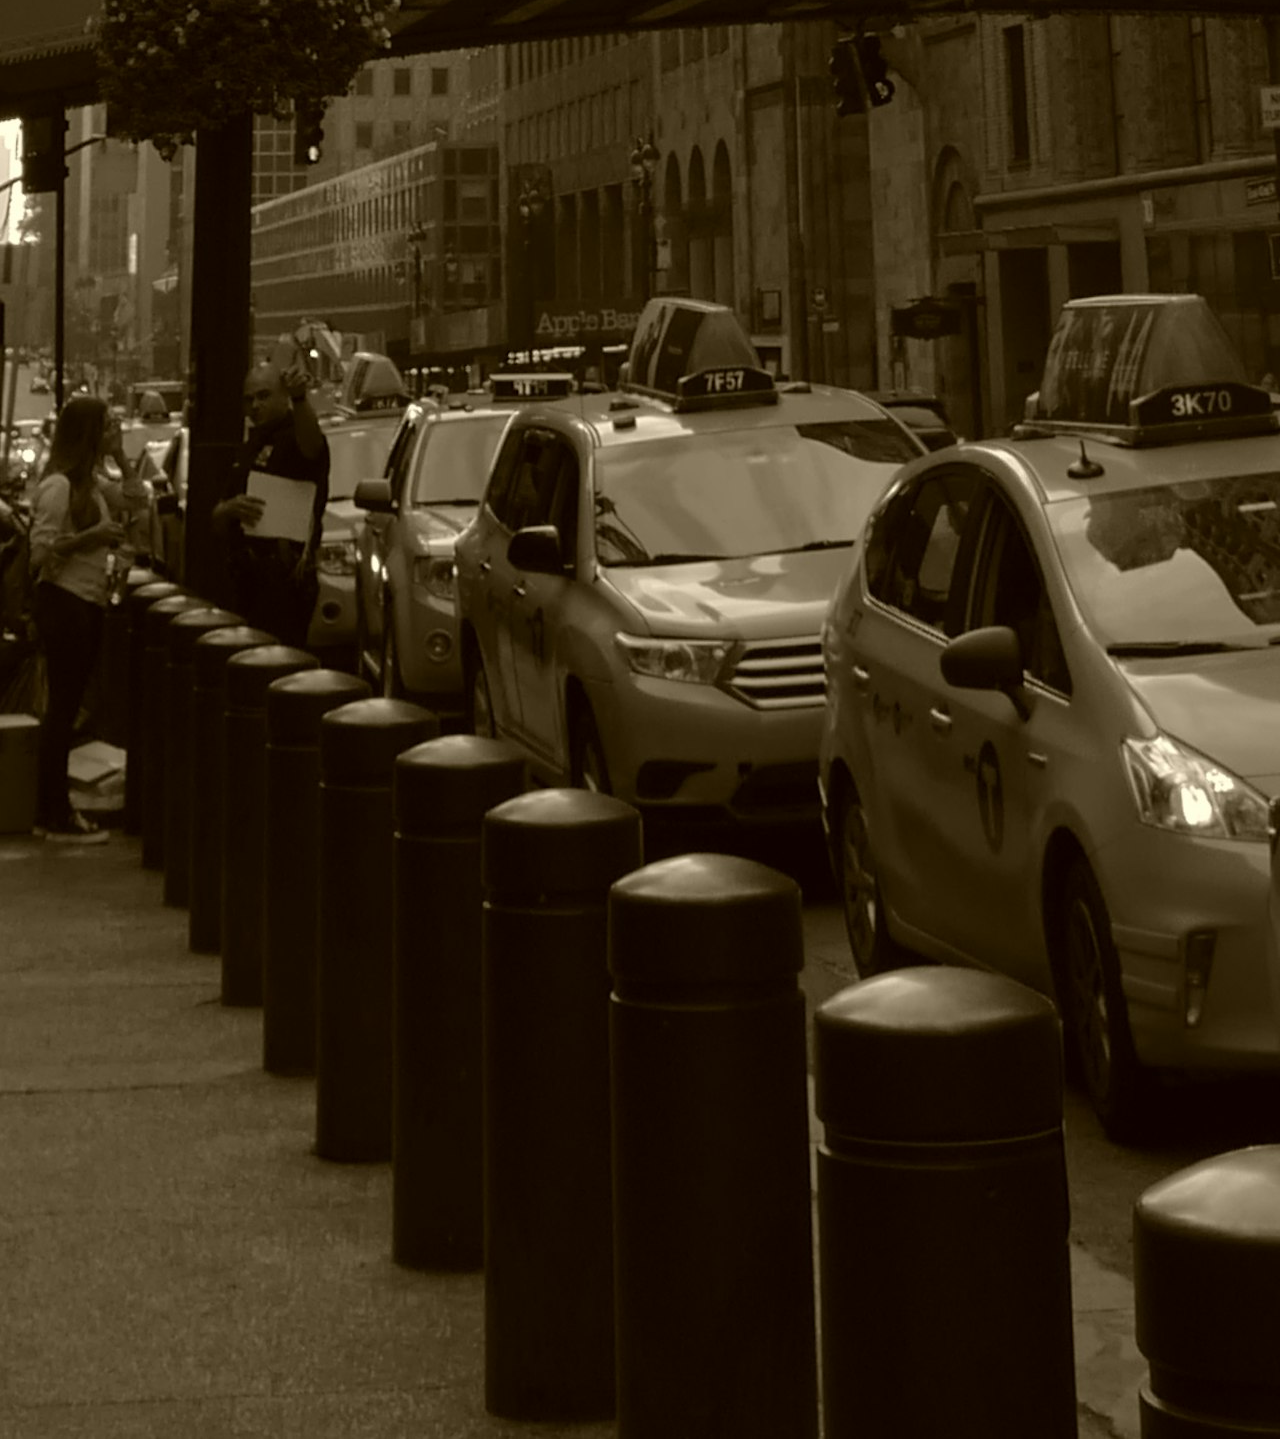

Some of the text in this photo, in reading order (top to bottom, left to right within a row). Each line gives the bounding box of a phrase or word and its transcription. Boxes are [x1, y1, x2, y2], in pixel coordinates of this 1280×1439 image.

[600, 307, 642, 331] Ban
[704, 369, 745, 392] 7F57
[1170, 390, 1232, 417] 3K70
